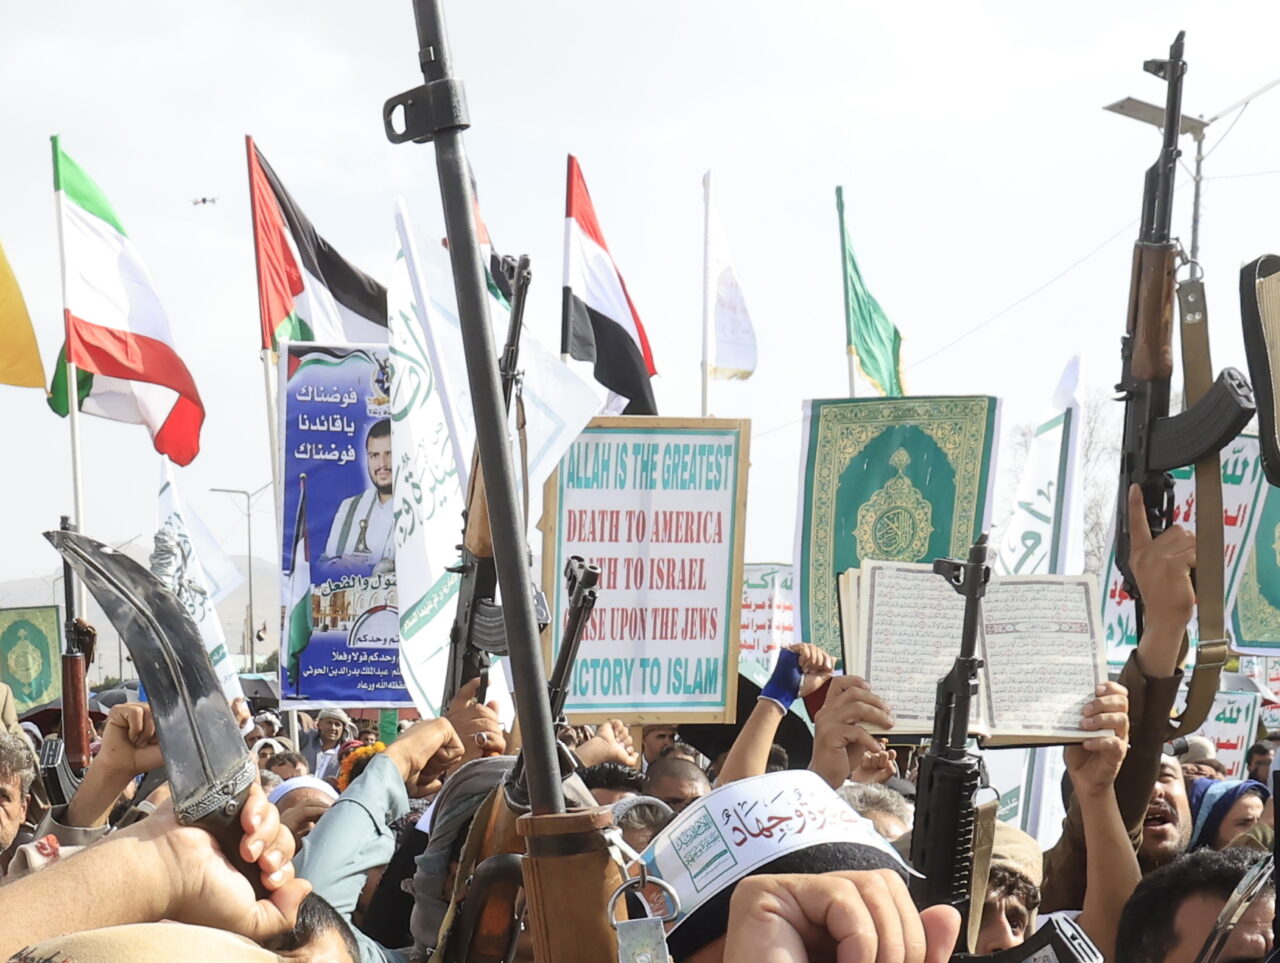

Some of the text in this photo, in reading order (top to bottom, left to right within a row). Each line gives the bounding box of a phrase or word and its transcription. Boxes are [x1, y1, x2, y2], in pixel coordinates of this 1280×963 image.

[296, 385, 358, 408] فوضناك
[295, 443, 356, 465] فوضناك
[567, 442, 733, 491] ALLAH IS THE GREATEST
[566, 509, 723, 544] DEATH TO AMERICA
[321, 575, 369, 597] والفعل
[624, 558, 645, 591] TO
[649, 558, 707, 591] ISRAEL
[356, 634, 387, 646] وحدكم
[610, 608, 648, 641] UPON
[652, 608, 679, 641] THE
[681, 608, 718, 641] JEWS
[573, 657, 636, 697] ICTORY
[639, 657, 662, 696] TO
[667, 657, 719, 696] ISLAM
